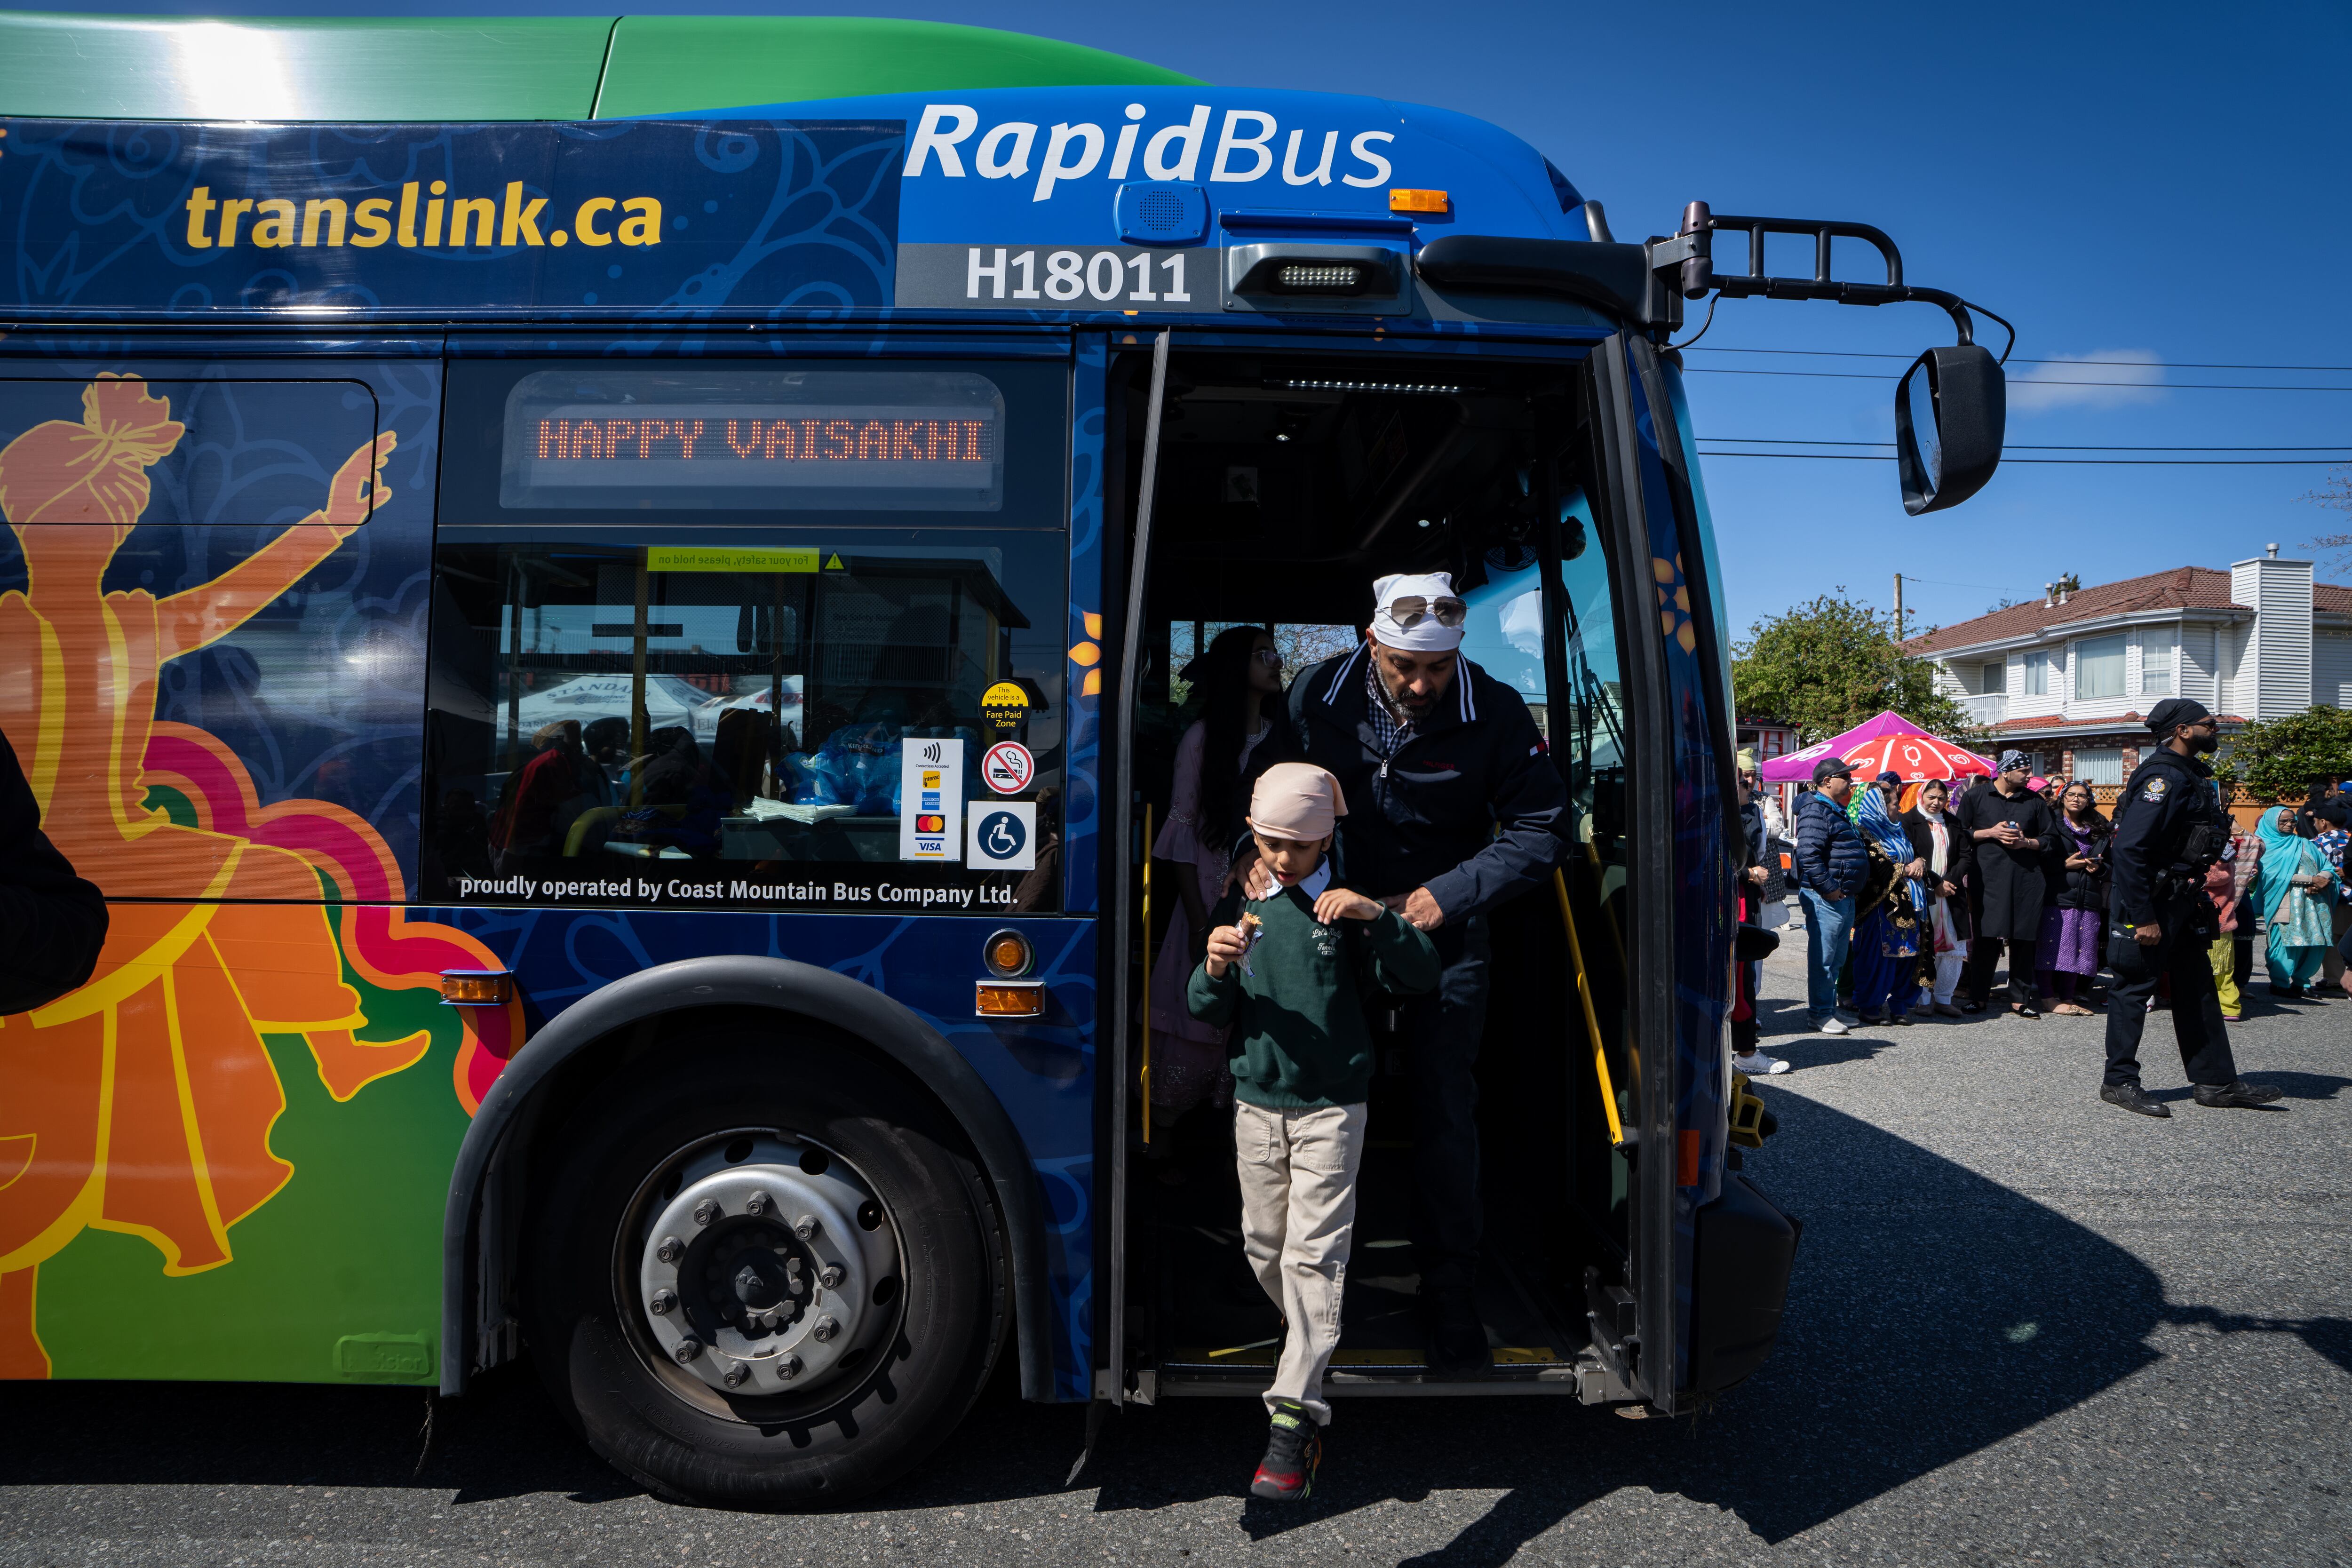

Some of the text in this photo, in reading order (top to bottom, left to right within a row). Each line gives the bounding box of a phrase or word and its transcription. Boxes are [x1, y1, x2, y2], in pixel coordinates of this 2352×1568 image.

[903, 103, 1395, 202] RapidBus
[186, 180, 661, 248] translink.ca
[967, 247, 1191, 302] H18011
[539, 419, 983, 461] HAPPY VAISAKHI
[546, 683, 651, 698] STANDAD
[923, 774, 940, 783] Interac
[918, 842, 941, 851] VISA
[461, 876, 1018, 907] proudly operated by Coast Mountain Bus Company Ltd.
[1312, 927, 1343, 940] Let's Rally
[704, 1436, 743, 1450] 305/70
